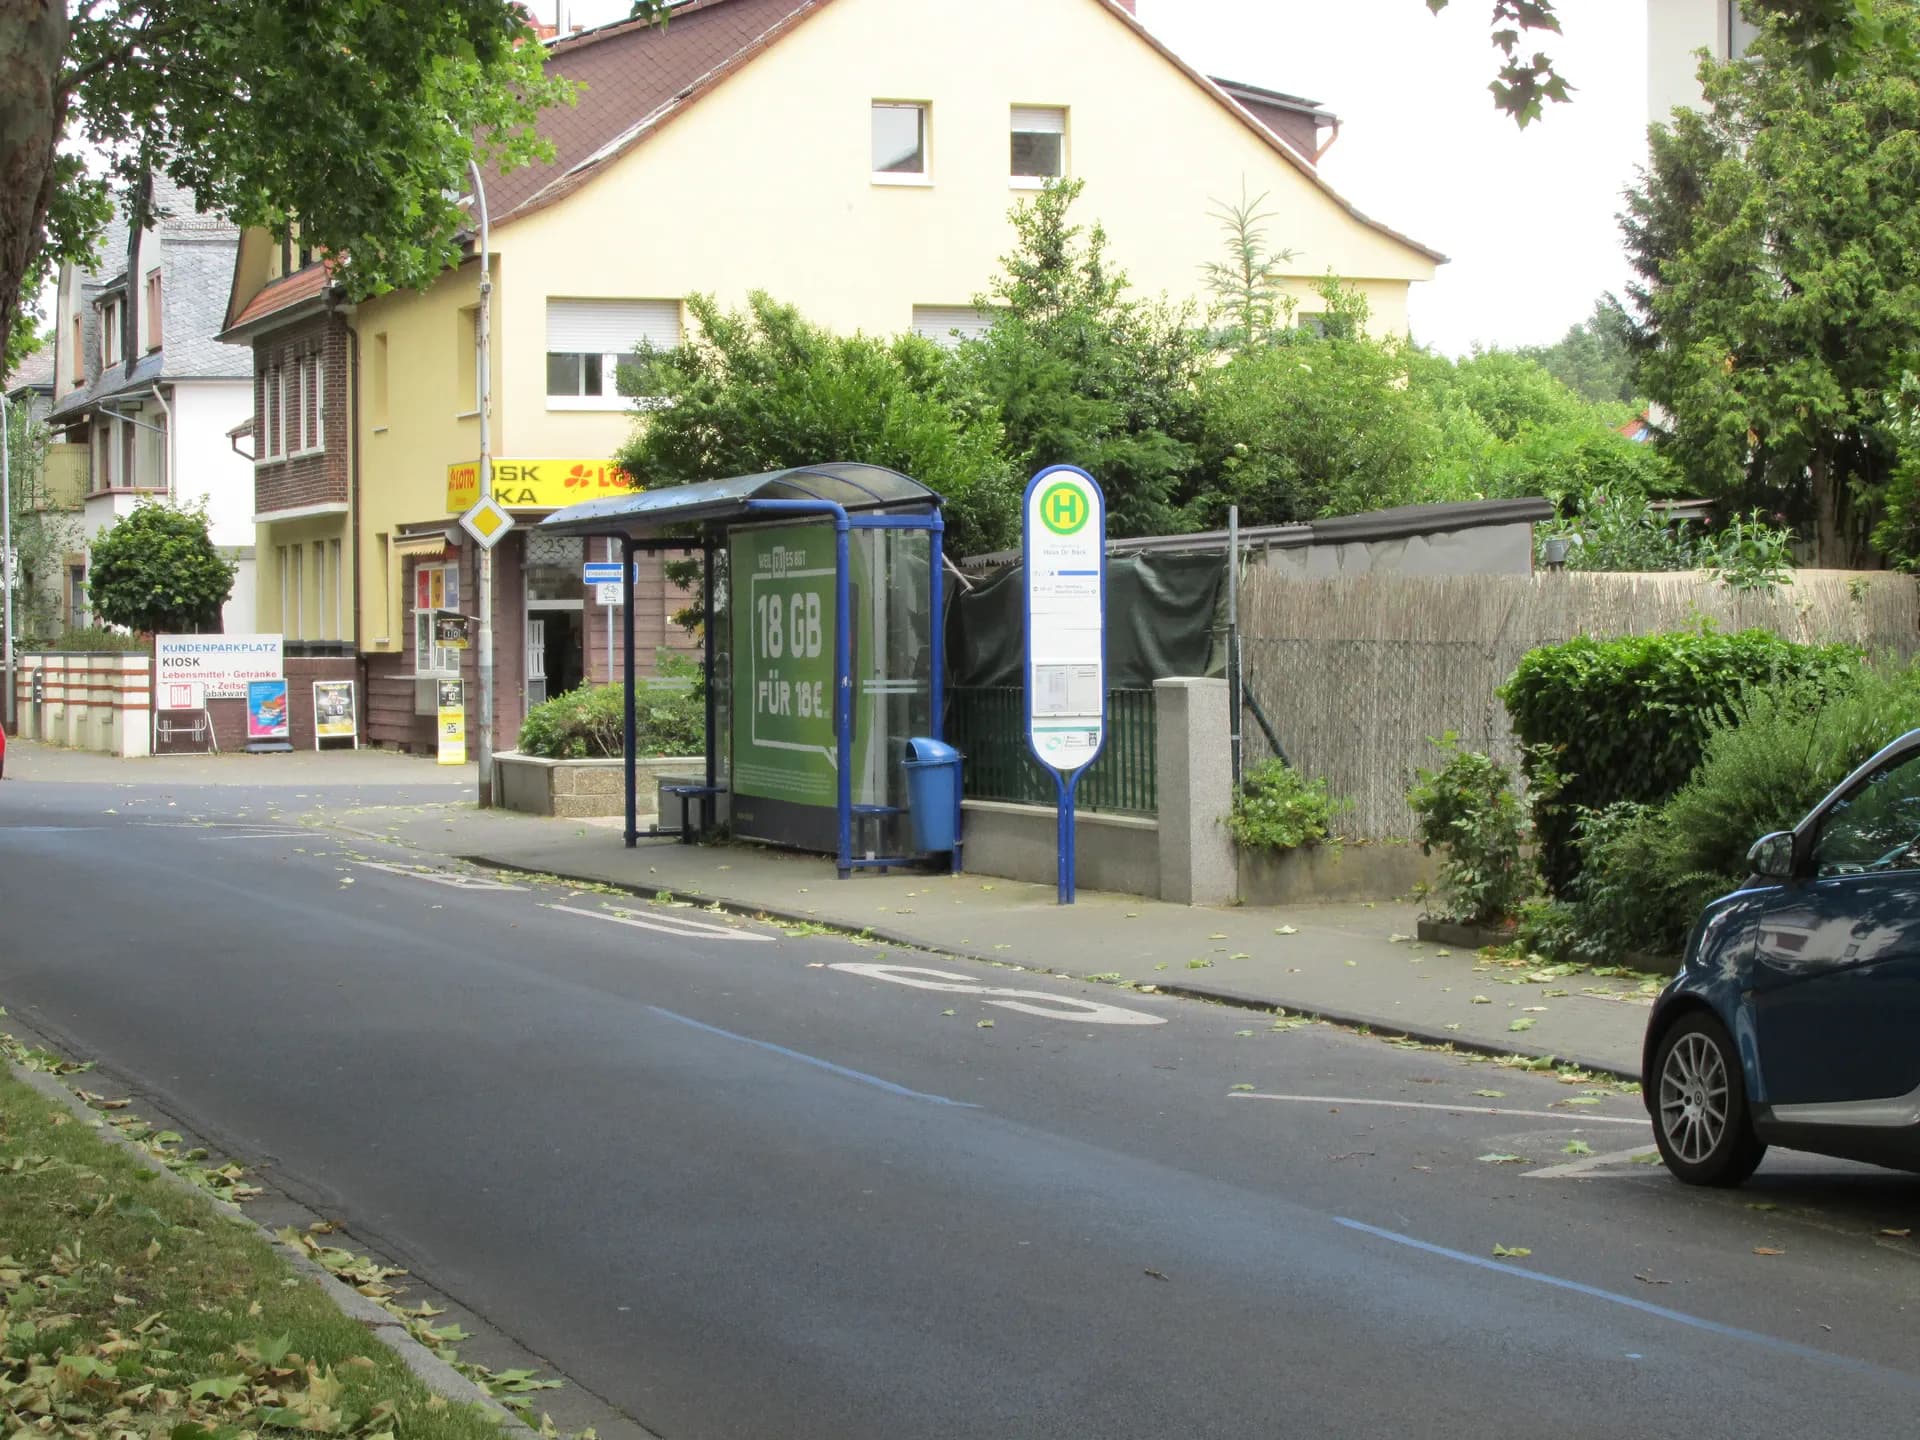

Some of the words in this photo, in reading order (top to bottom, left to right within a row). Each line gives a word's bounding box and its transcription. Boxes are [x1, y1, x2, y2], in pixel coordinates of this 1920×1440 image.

[455, 467, 475, 490] LOTTO
[1053, 494, 1077, 523] H
[758, 594, 783, 659] 18
[790, 592, 822, 659] GB
[162, 643, 277, 653] KUNDENPARKPLATZ
[162, 657, 201, 667] KIOSK
[162, 671, 225, 679] Lebensmittel
[758, 669, 791, 716] FÜR
